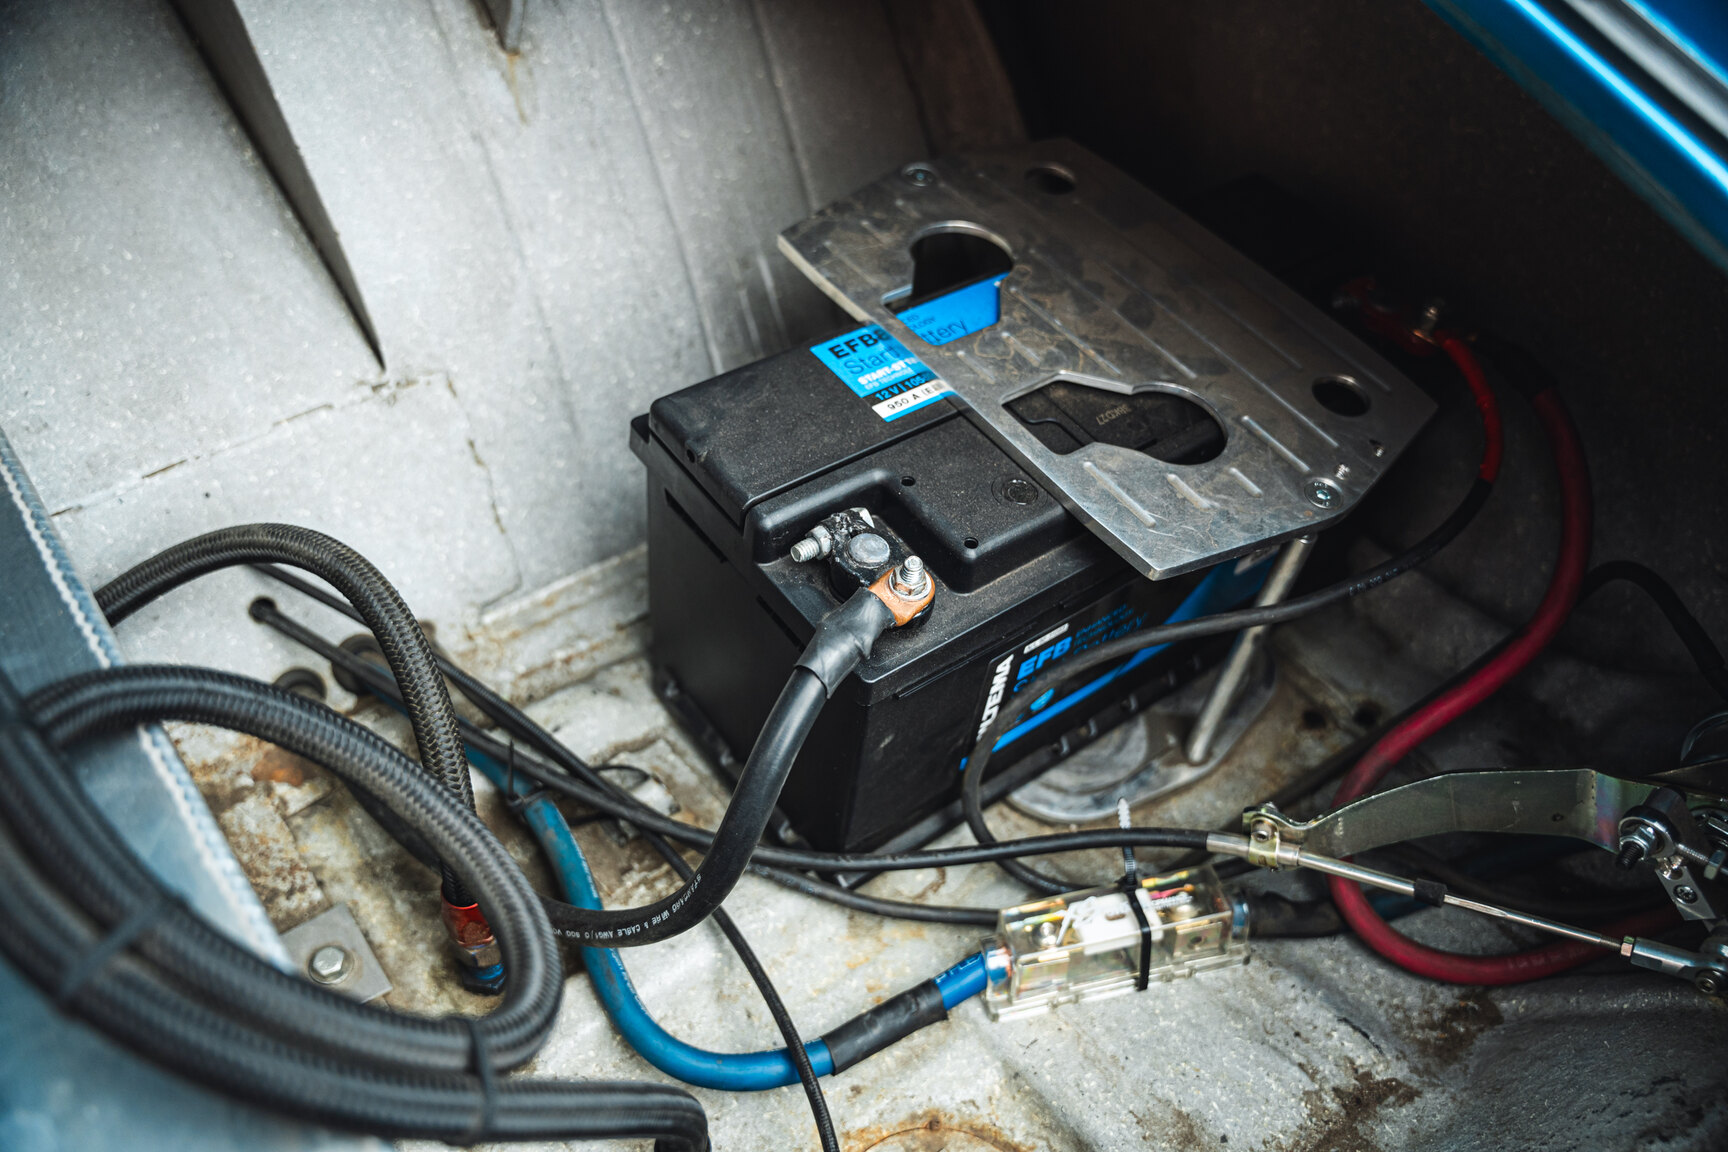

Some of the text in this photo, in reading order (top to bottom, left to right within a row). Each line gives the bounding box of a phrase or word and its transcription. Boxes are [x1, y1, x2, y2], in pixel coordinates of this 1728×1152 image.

[828, 333, 879, 359] EFB
[887, 397, 910, 410] 950
[1016, 636, 1073, 680] EFB
[671, 873, 702, 913] STANDARD
[651, 909, 670, 926] WIRE
[617, 924, 641, 937] CABLE
